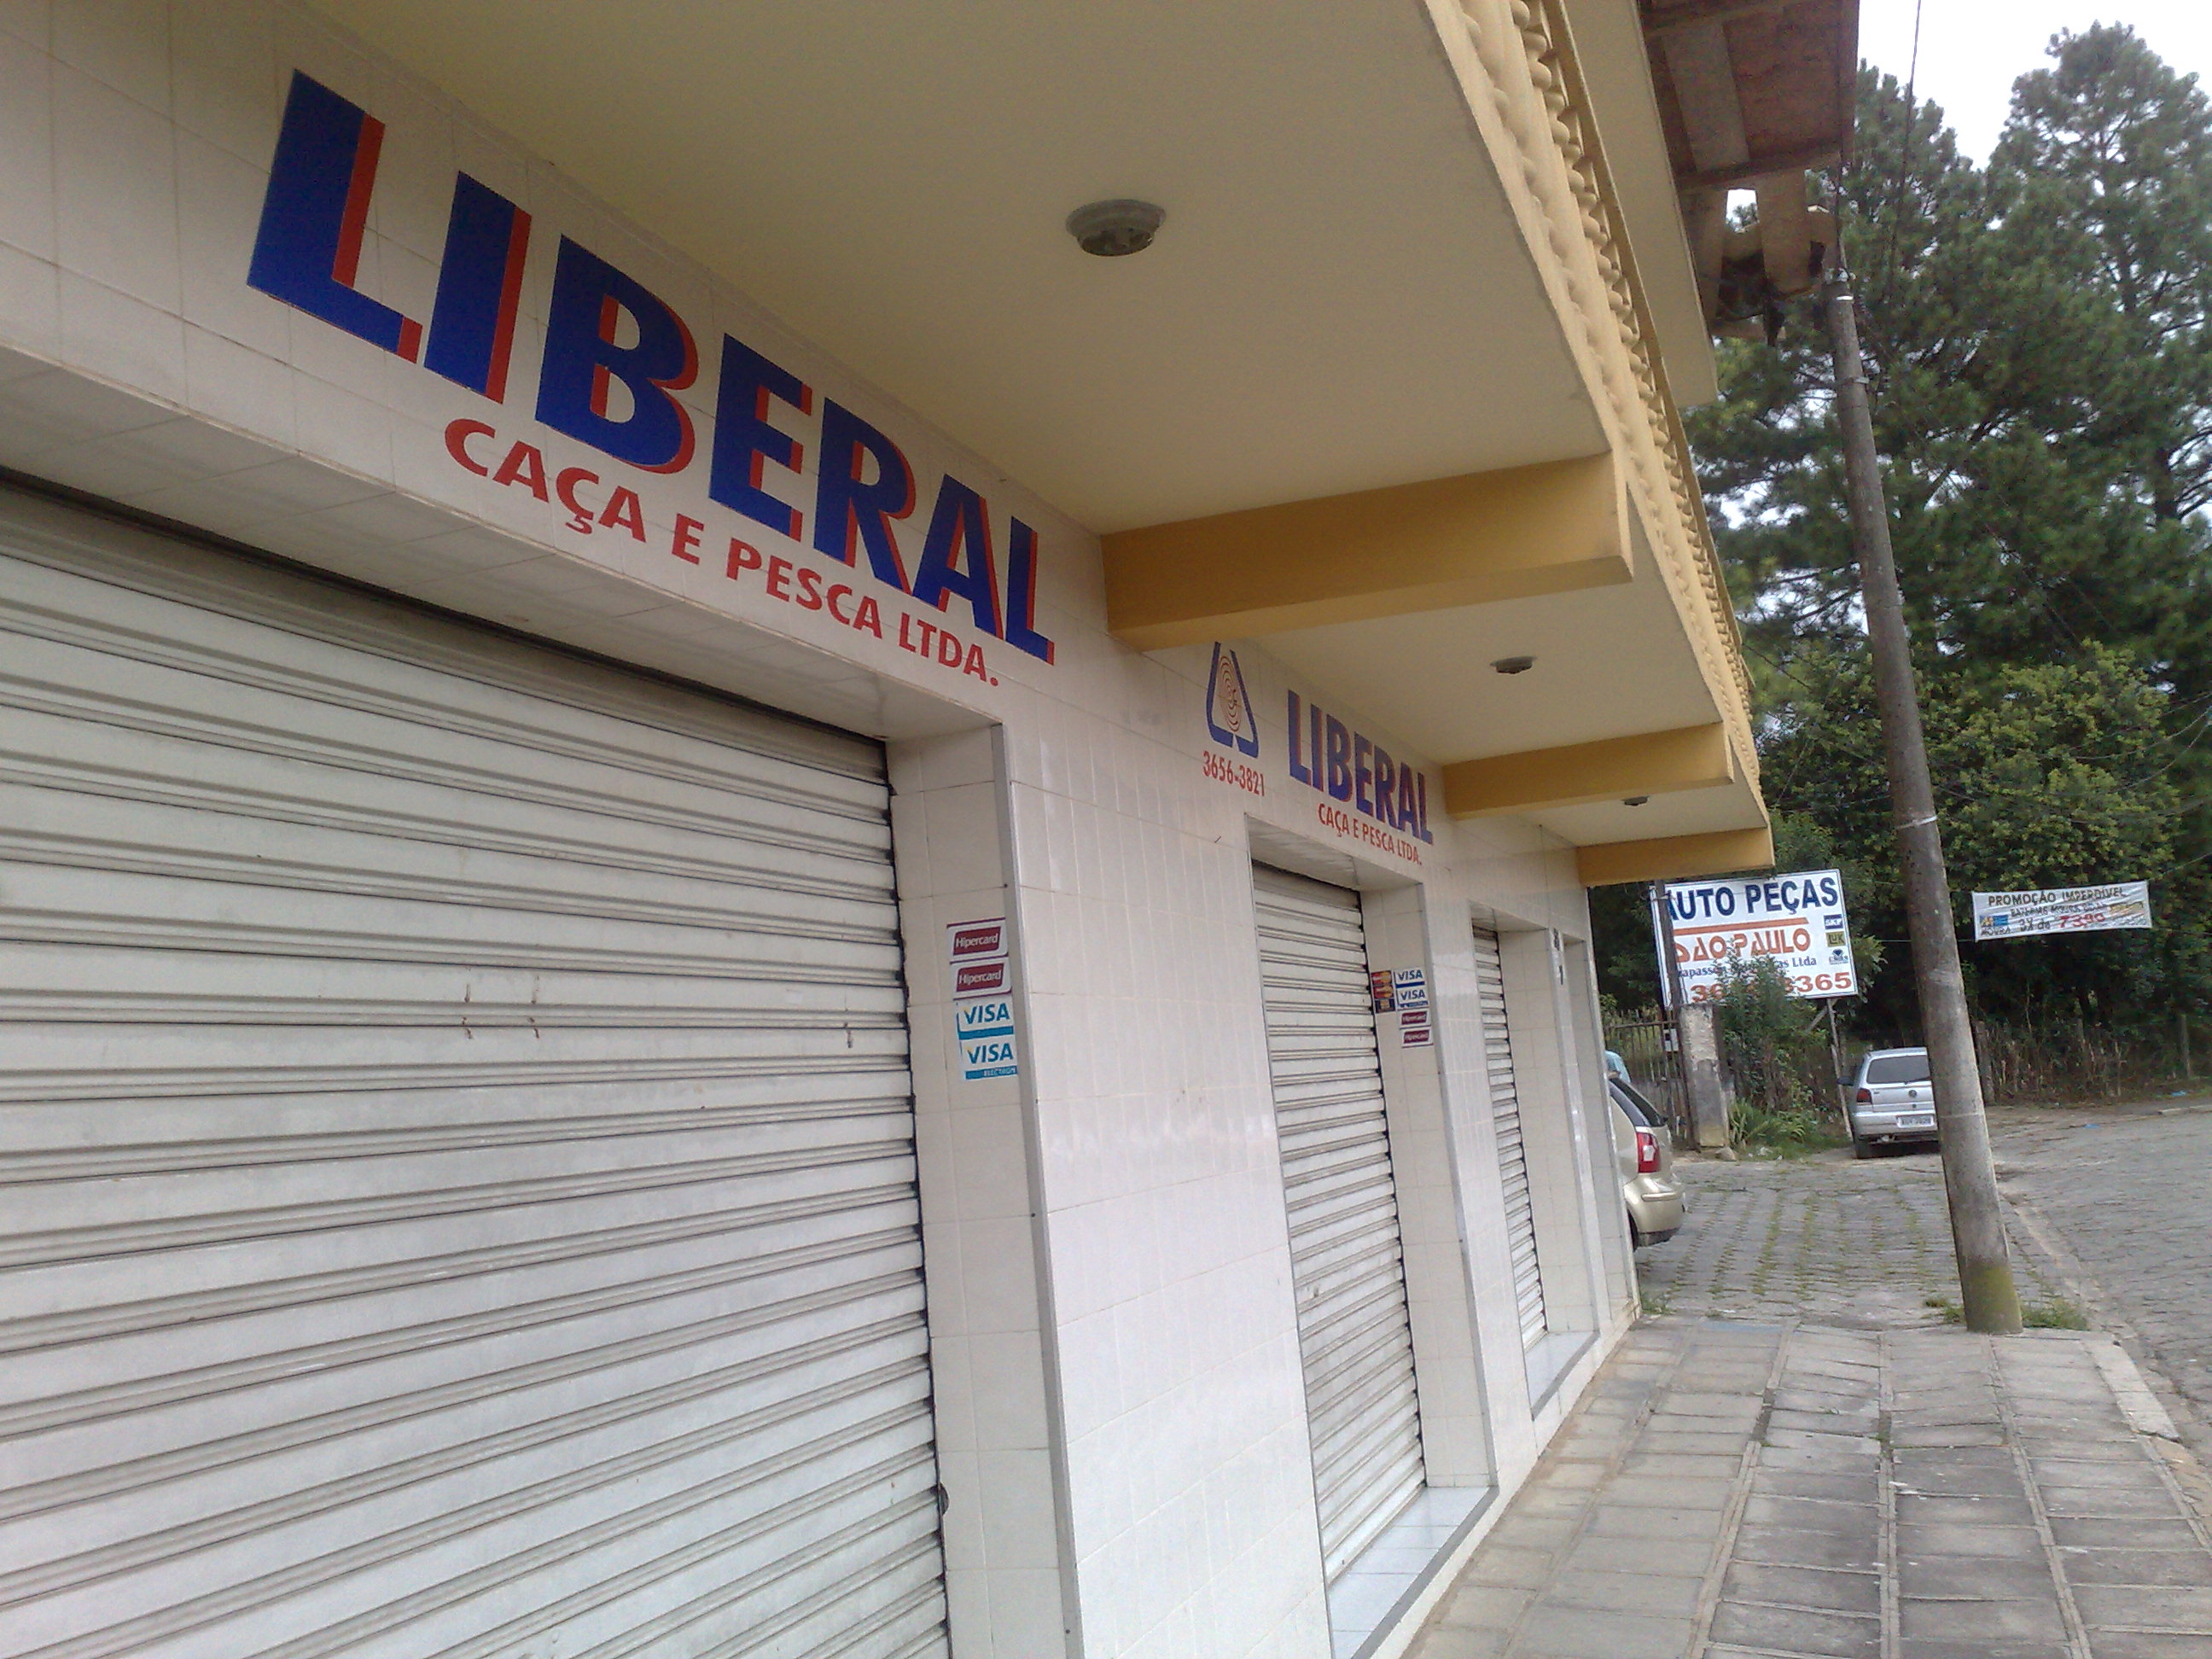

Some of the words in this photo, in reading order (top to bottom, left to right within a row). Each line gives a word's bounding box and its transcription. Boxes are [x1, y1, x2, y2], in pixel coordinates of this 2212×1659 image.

[247, 68, 1055, 665] LIBERAL
[445, 418, 646, 543] CAÇA
[672, 513, 704, 565] E
[726, 538, 882, 639] PESCA
[899, 612, 998, 687] LTDA.
[1202, 750, 1265, 797] 3656-3821
[1288, 690, 1434, 846] LIBERAL
[1318, 803, 1349, 837] CAÇA
[1353, 818, 1359, 838] E
[1362, 823, 1394, 853] PESCA
[1397, 839, 1423, 865] LTDA.
[1745, 877, 1838, 915] PEÇAS
[1988, 890, 2056, 906] PROMOÇÃO
[956, 933, 998, 949] Hipercard
[1732, 928, 1811, 956] PAULO
[1792, 956, 1817, 967] Ltda
[958, 969, 1002, 985] Hipercard
[1398, 969, 1423, 981] VISA
[1400, 989, 1425, 1000] VISA
[963, 1003, 1010, 1024] VISA
[967, 1043, 1014, 1064] VISA
